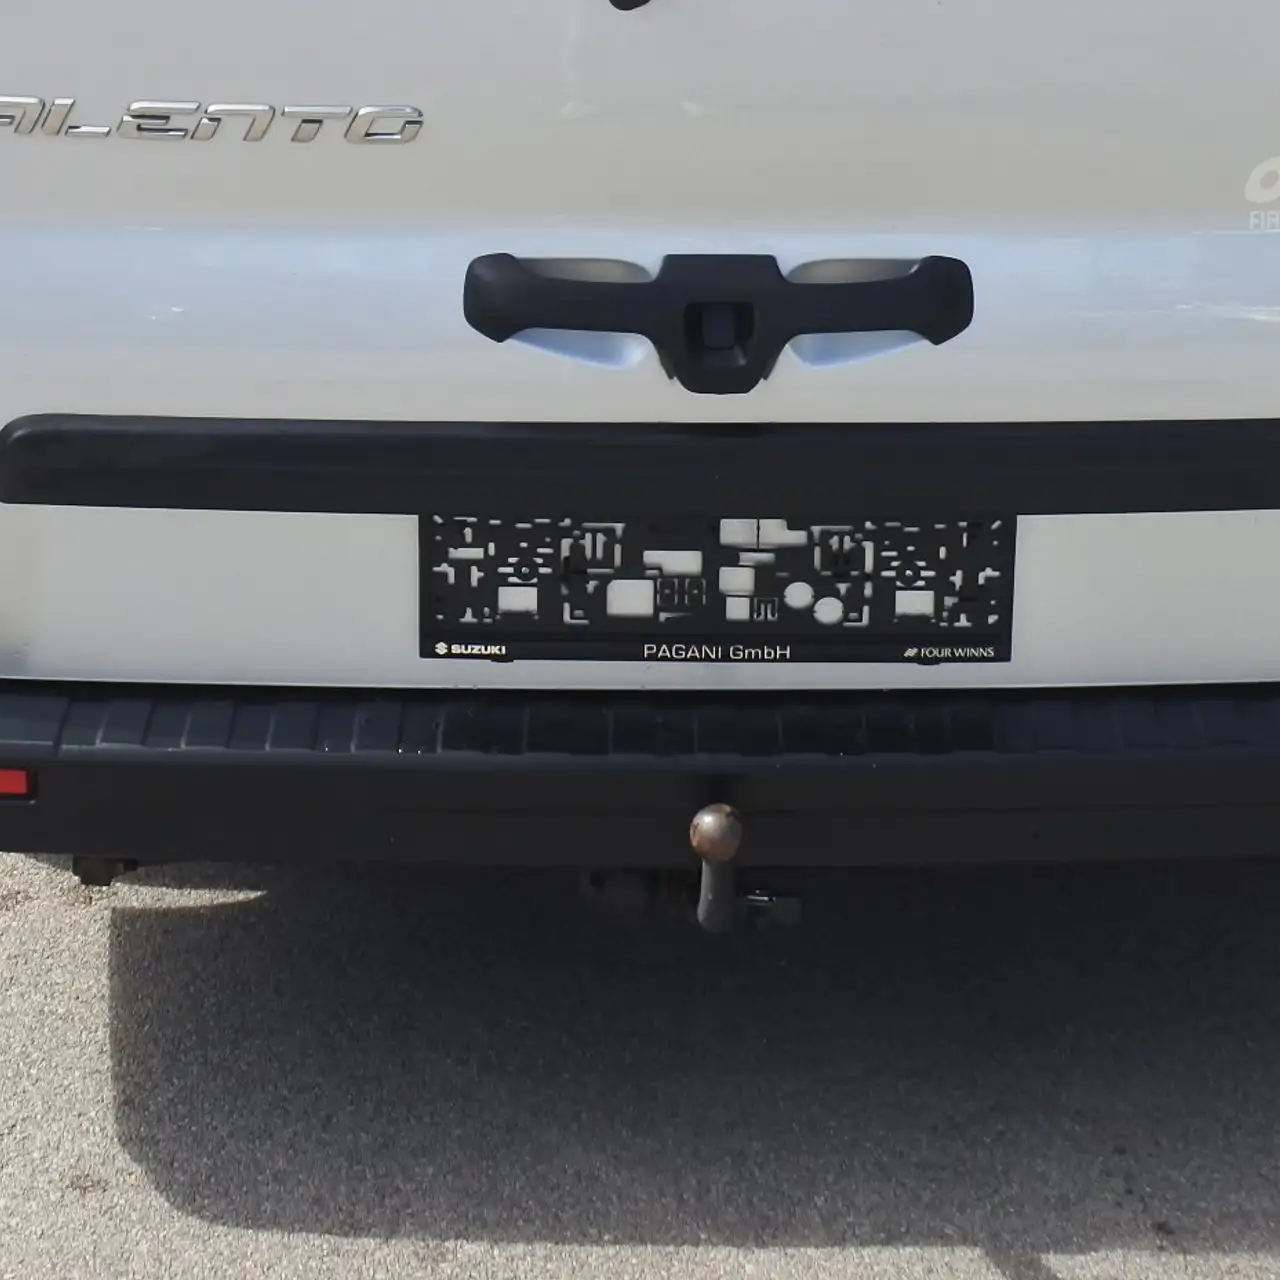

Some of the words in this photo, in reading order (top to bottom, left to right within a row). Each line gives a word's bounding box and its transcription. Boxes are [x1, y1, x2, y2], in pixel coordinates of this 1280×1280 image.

[450, 644, 507, 655] SUZUKI
[642, 643, 723, 660] PAGANI
[729, 644, 791, 660] GmbH
[920, 646, 953, 658] FOUR
[953, 647, 996, 658] WINNS
